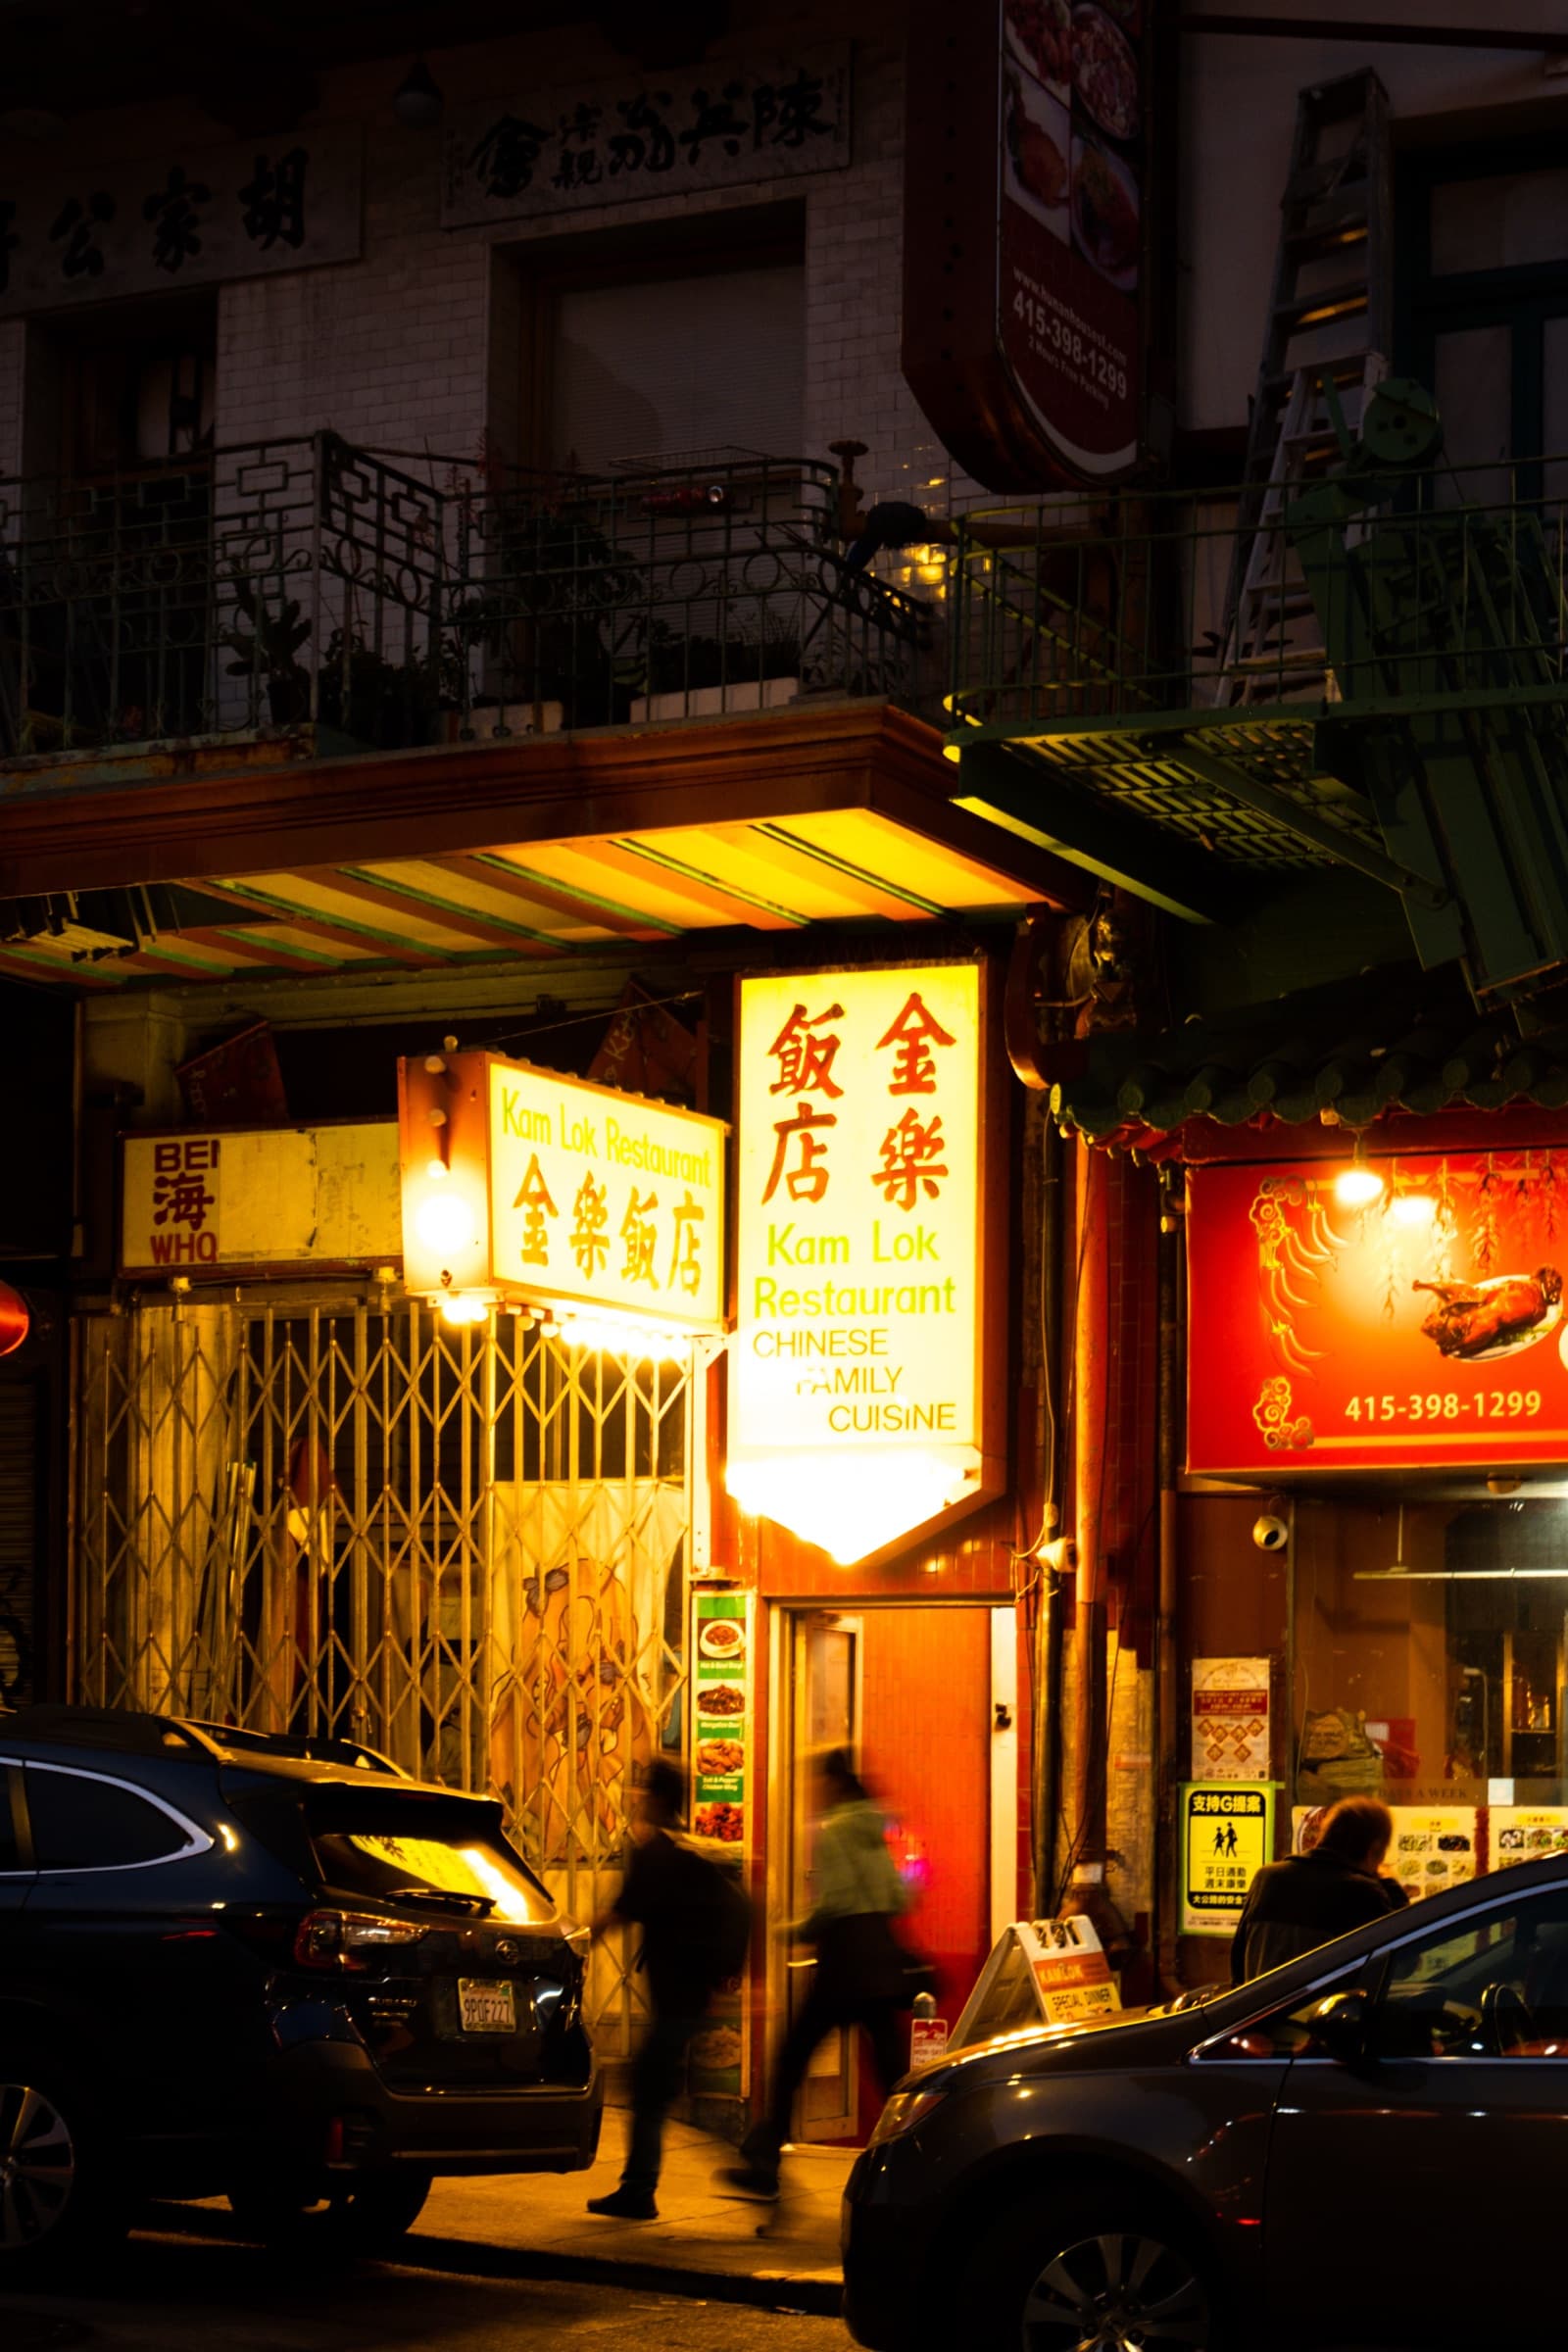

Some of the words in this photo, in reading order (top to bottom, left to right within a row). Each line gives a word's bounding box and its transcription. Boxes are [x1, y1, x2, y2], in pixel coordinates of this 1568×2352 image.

[1012, 290, 1127, 400] 415-398-1299
[501, 1087, 552, 1146] Kam
[560, 1102, 598, 1157] Lok
[605, 1116, 710, 1188] Restaurant
[153, 1172, 215, 1231] 海
[513, 1152, 706, 1298] 金樂飯店
[767, 1222, 850, 1266] Kam
[872, 1219, 940, 1263] Lok
[754, 1277, 956, 1318] Restaurant
[753, 1329, 889, 1358] CHINESE
[828, 1403, 956, 1432] CUISINE
[1345, 1391, 1543, 1422] 415-398-1299
[1193, 1894, 1249, 1905] 大公路的安全
